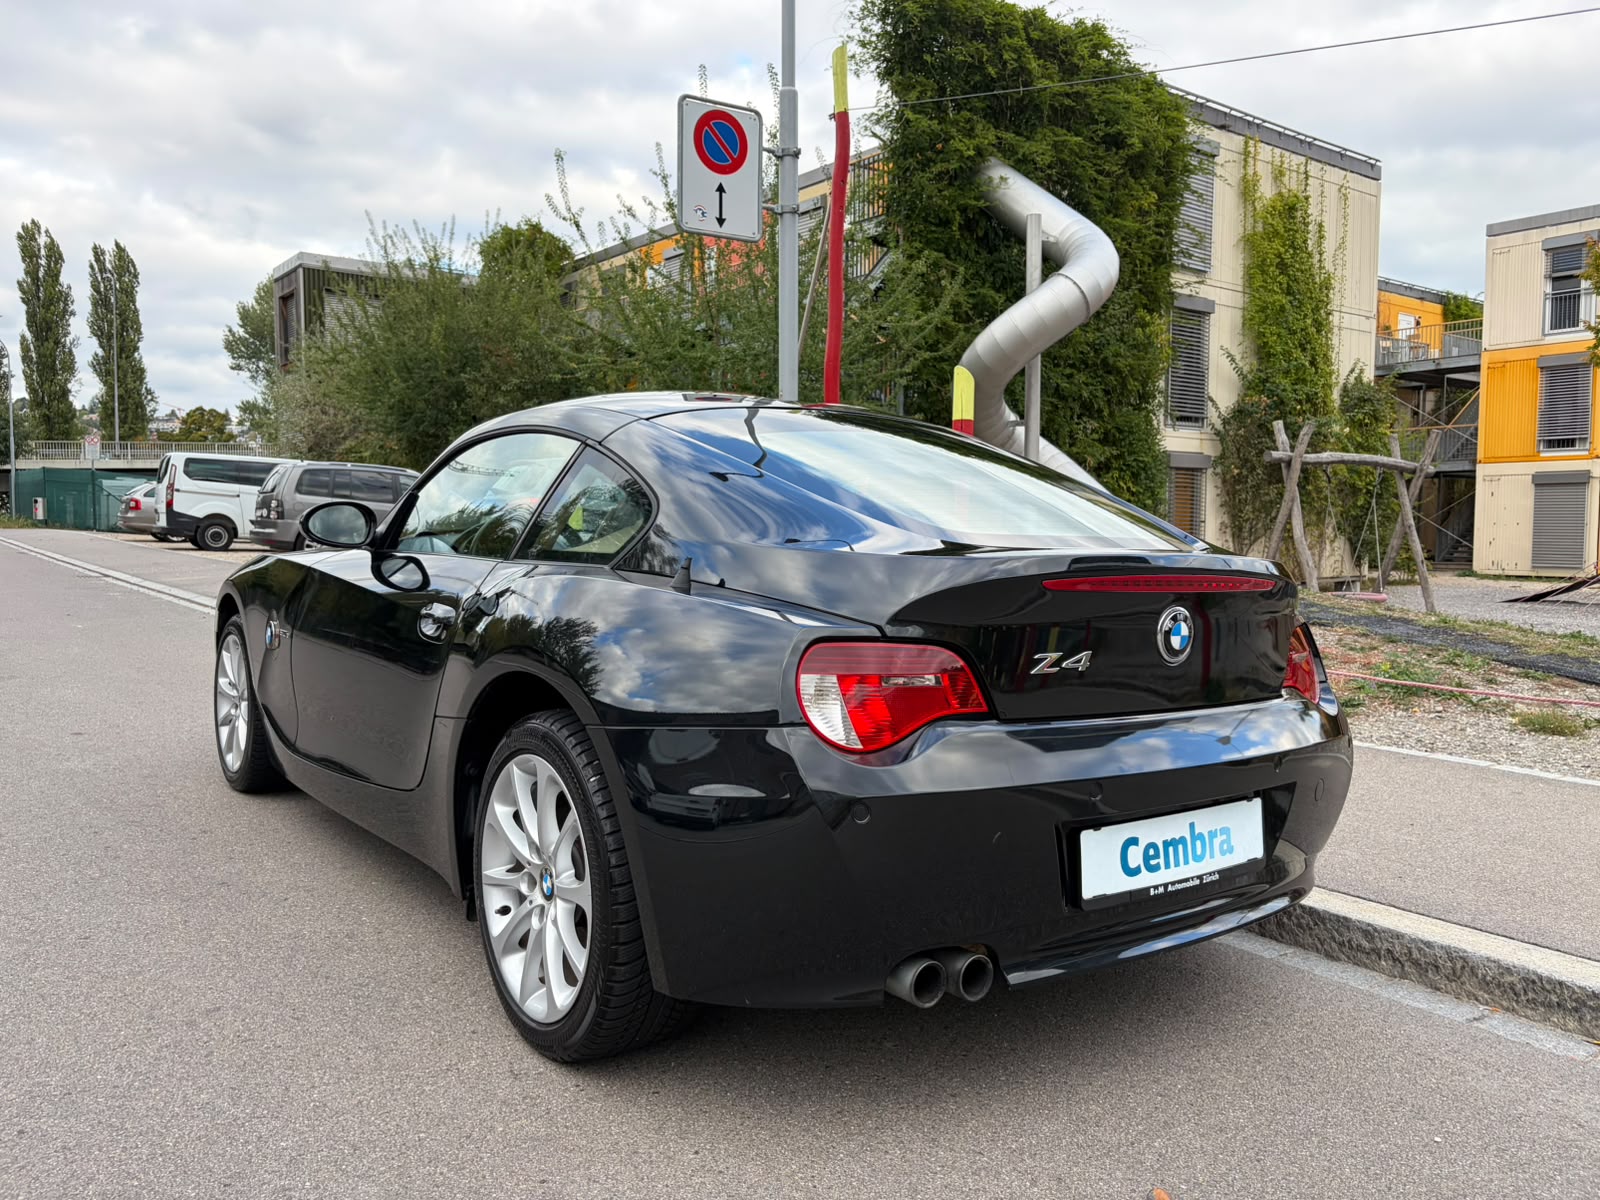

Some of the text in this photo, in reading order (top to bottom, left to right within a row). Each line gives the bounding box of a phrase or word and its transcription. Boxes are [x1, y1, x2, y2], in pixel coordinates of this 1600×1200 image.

[1030, 651, 1093, 674] Z4
[1120, 821, 1235, 877] Cembra
[1149, 872, 1220, 896] B+M Automobile Zürich
